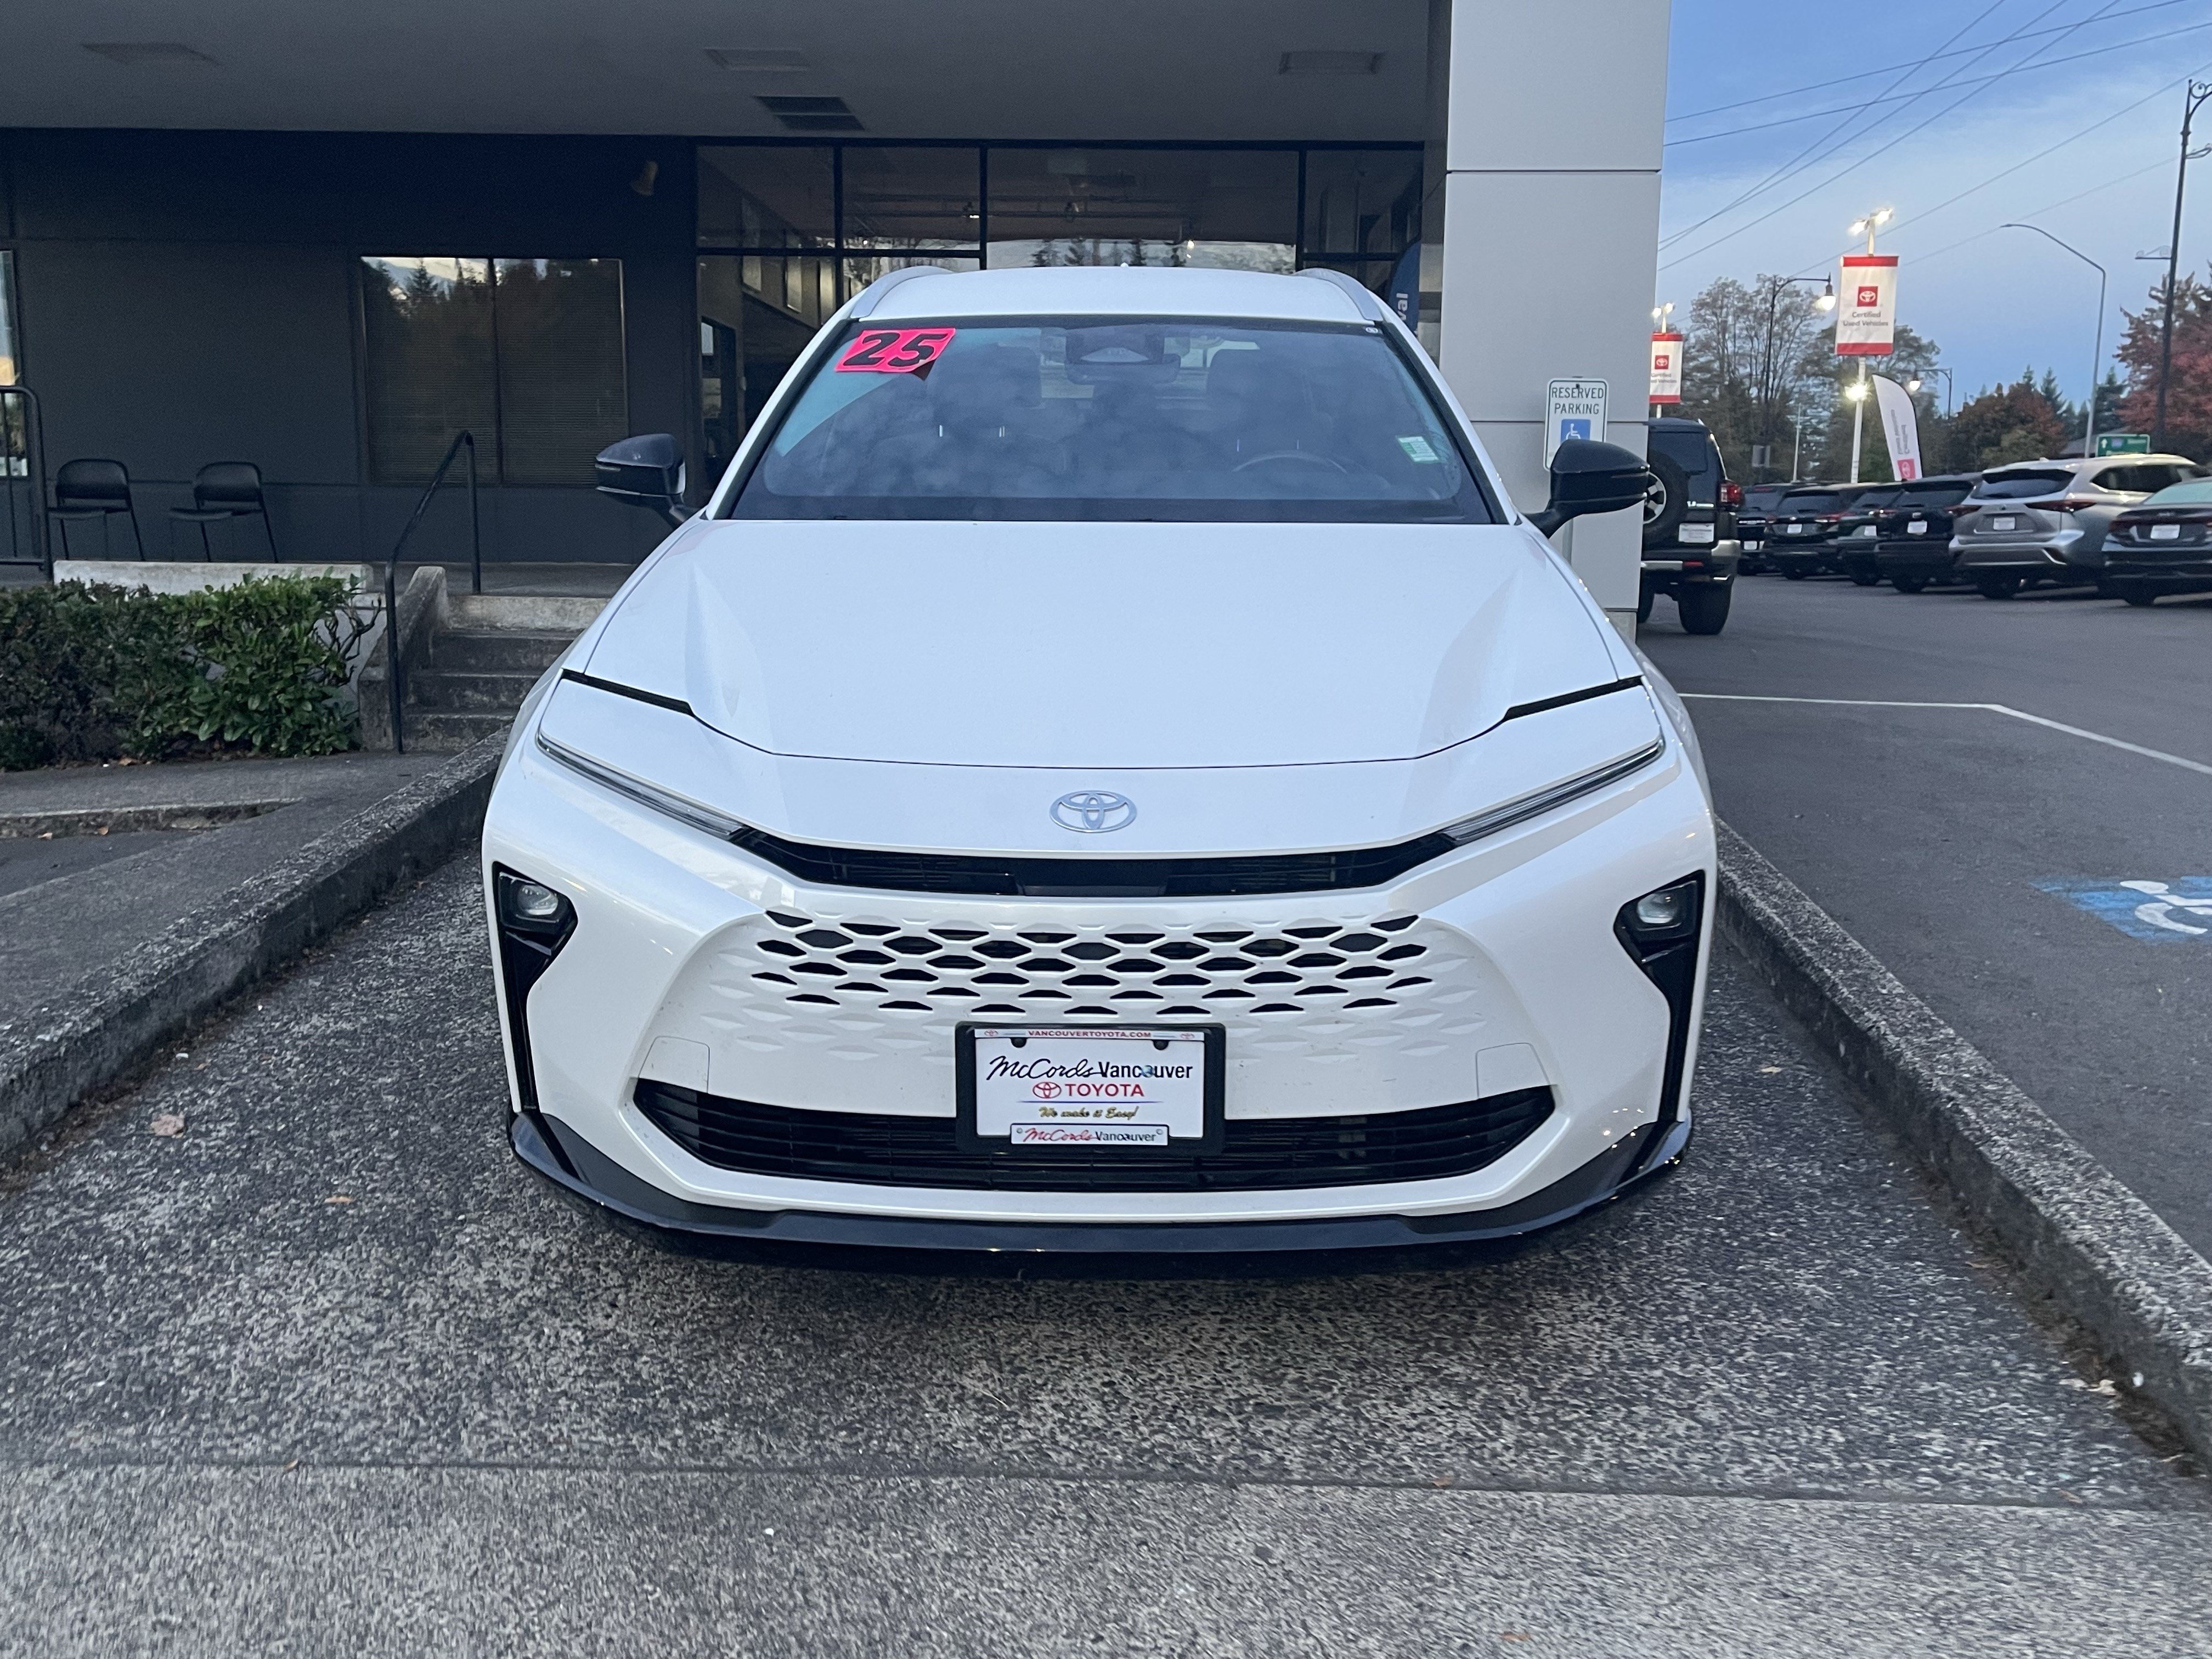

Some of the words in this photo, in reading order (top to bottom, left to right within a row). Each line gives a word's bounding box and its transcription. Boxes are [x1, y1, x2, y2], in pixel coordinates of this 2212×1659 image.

[843, 332, 948, 367] 25
[1551, 387, 1604, 399] RESERVED
[1554, 402, 1599, 415] PARKING
[1064, 1084, 1144, 1097] TOYOTA
